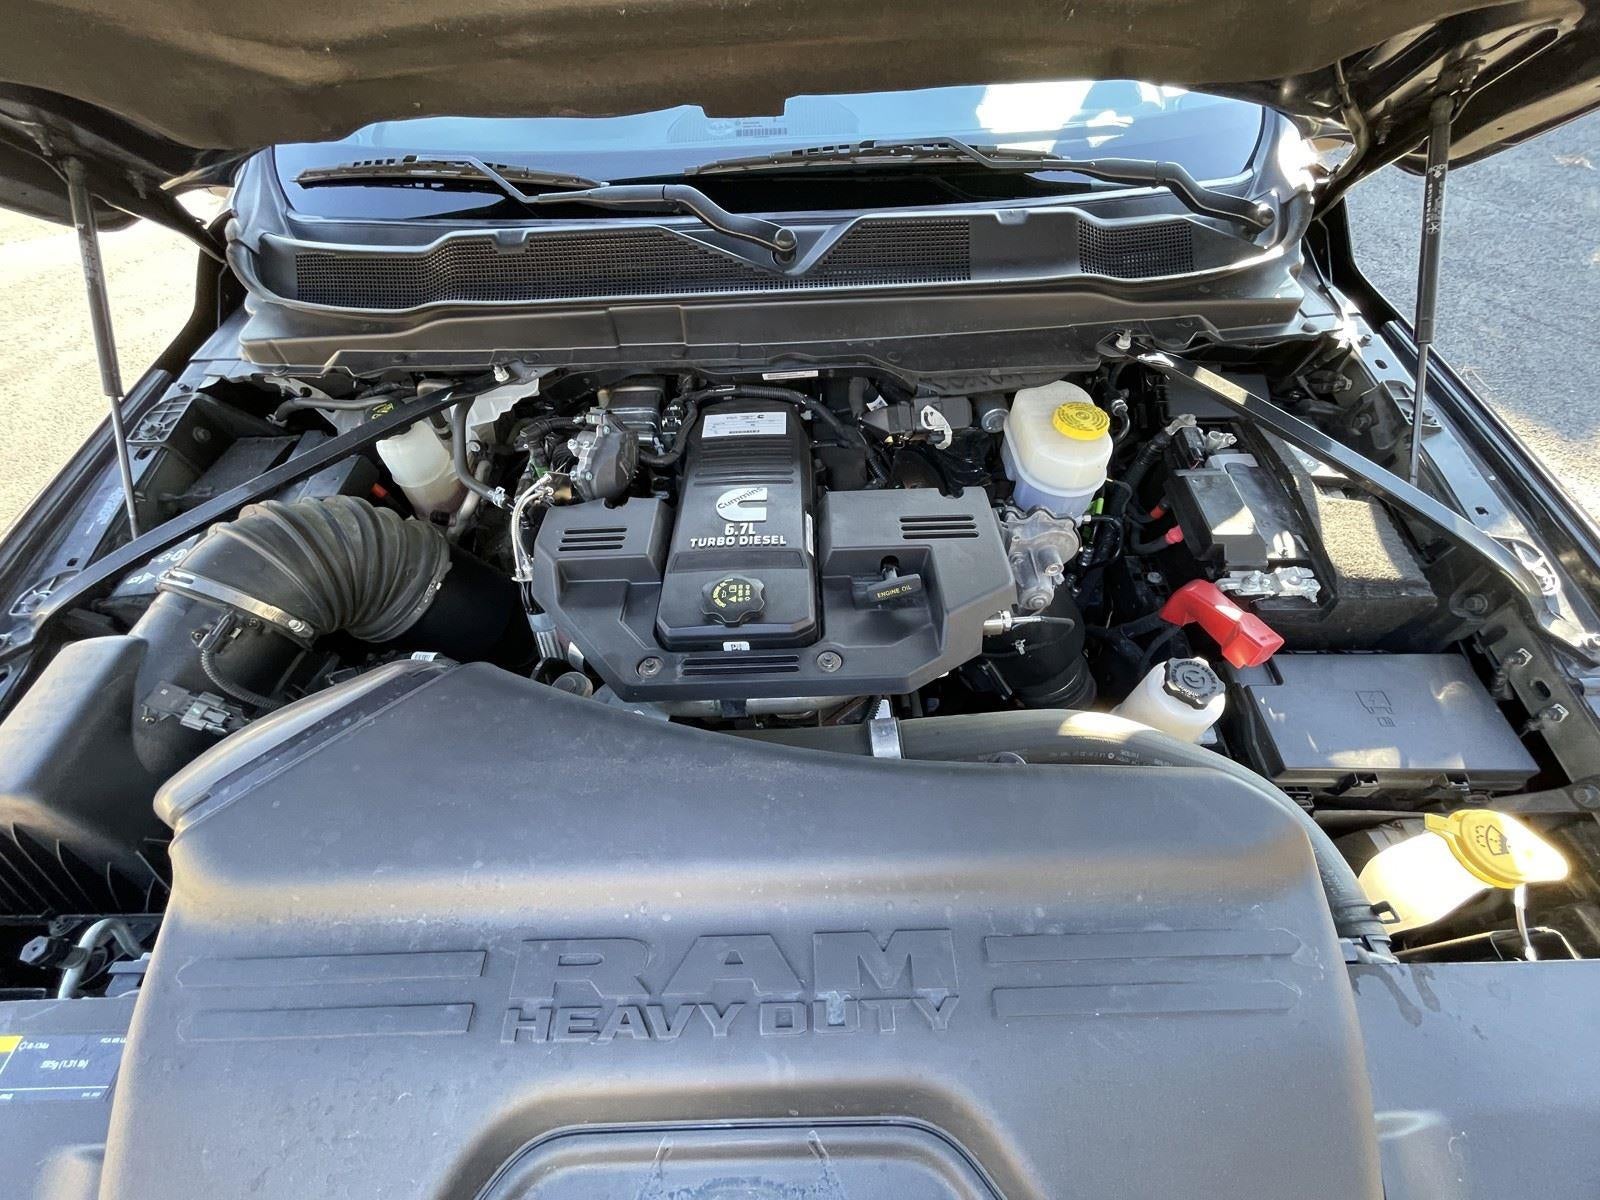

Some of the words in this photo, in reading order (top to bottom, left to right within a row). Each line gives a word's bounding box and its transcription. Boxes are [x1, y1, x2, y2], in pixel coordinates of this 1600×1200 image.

[717, 487, 764, 510] Cummins
[724, 522, 756, 536] 6.7L
[690, 536, 736, 548] TURBO
[739, 535, 787, 546] DIESEL
[876, 587, 900, 598] ENGINE
[901, 584, 912, 592] OIL
[509, 928, 959, 1000] RAM
[500, 1002, 748, 1044] HEAVY
[759, 997, 961, 1036] DUTY
